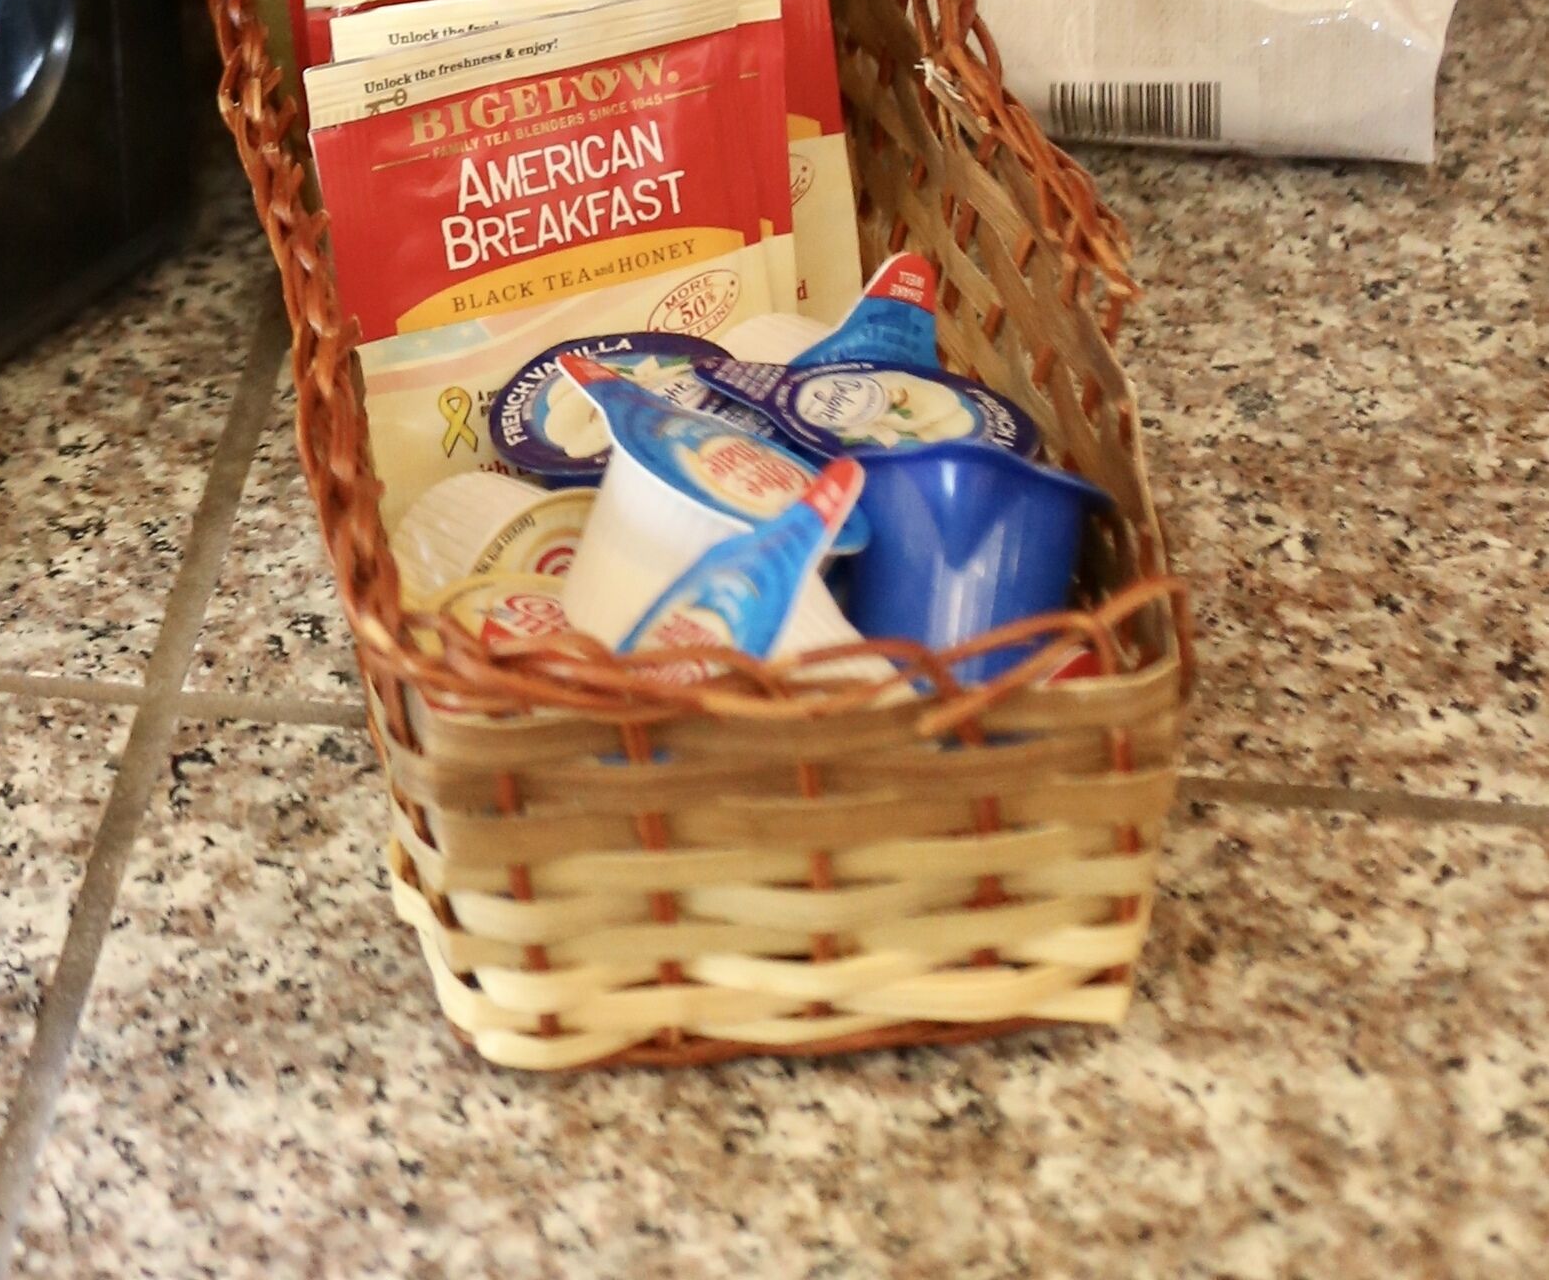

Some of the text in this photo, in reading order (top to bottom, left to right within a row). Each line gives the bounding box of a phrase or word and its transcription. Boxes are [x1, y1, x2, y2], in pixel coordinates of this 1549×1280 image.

[364, 38, 560, 95] Unlock the freshness & enjoy!
[388, 28, 440, 46] Unlock
[432, 138, 479, 160] FAMILY
[484, 130, 512, 148] TEA
[515, 112, 585, 140] BLENDERS
[588, 101, 628, 122] SINCE
[458, 120, 664, 213] AMERICAN
[441, 169, 685, 271] BREAKFAST
[452, 239, 696, 313] BLACK TEA and HONEY
[664, 275, 714, 310] MORE
[680, 290, 717, 326] 50%
[501, 381, 536, 446] FRENCH
[525, 338, 633, 380] VAILLA
